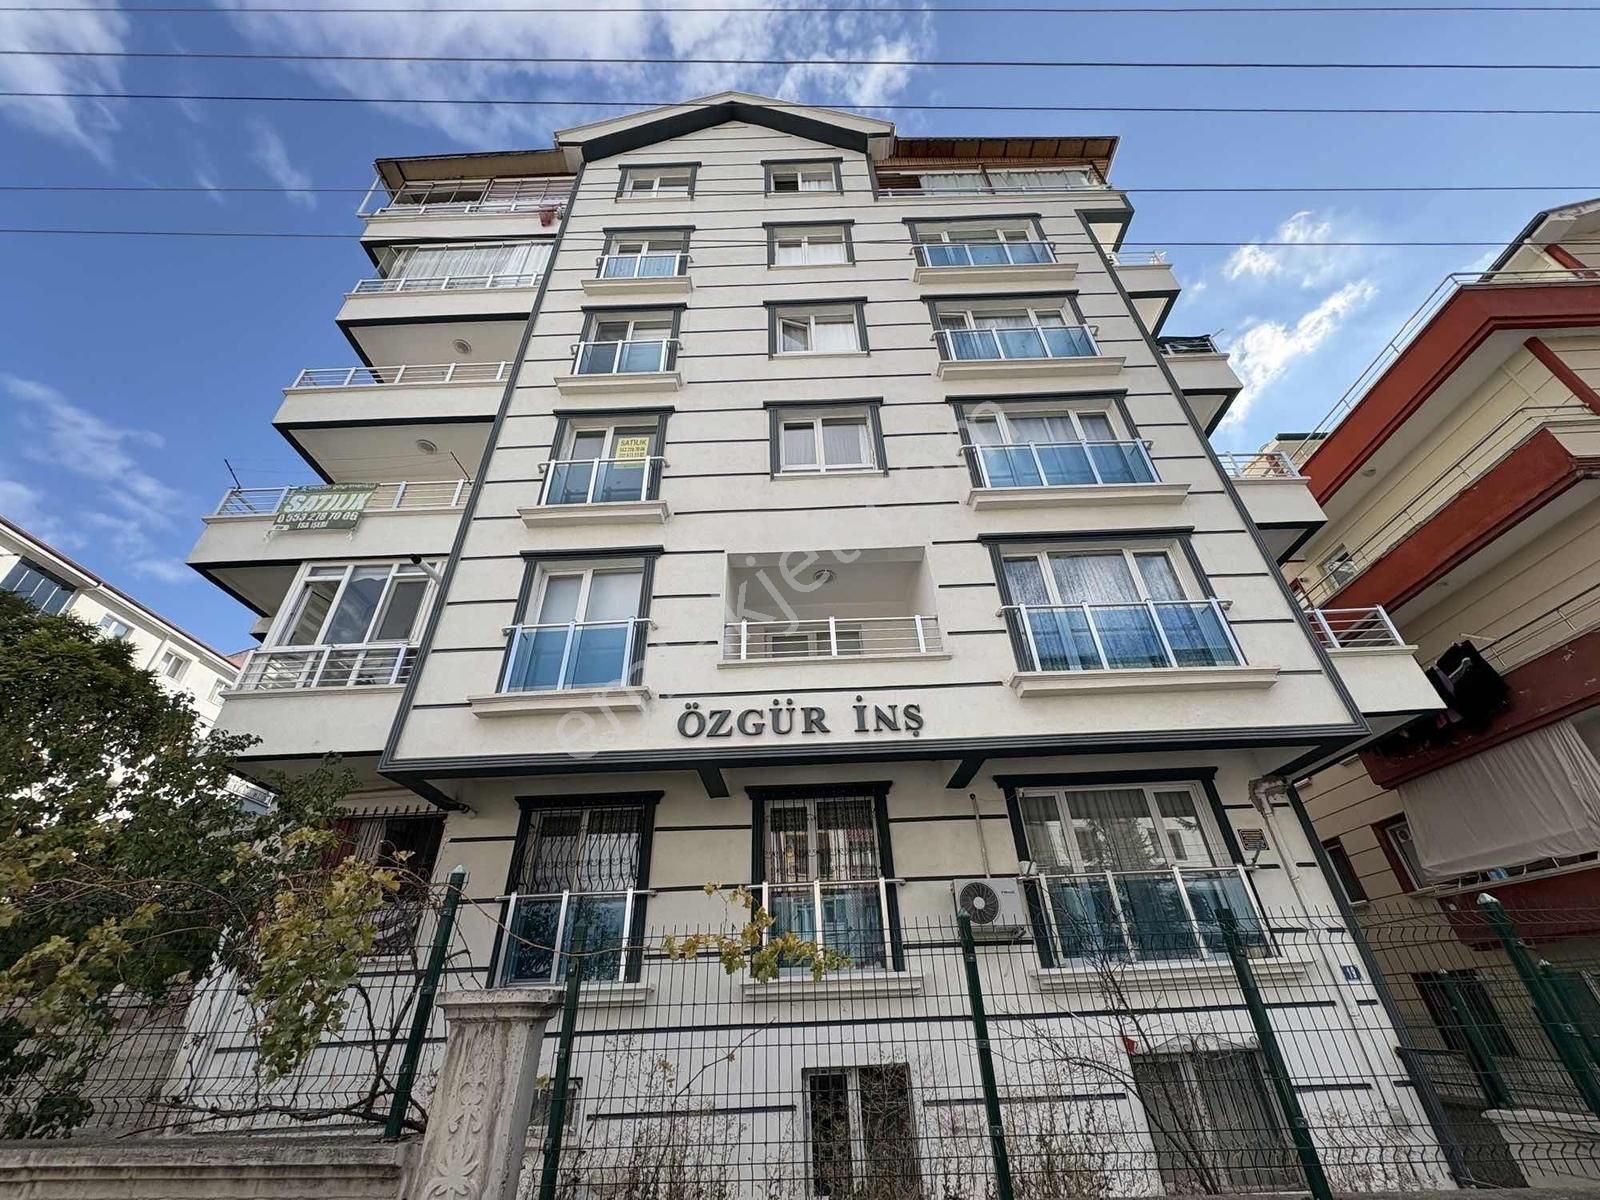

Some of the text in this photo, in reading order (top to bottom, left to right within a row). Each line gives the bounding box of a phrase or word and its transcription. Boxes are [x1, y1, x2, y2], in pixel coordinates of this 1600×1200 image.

[284, 492, 373, 512] SATILIK
[277, 514, 285, 523] 0
[328, 511, 341, 520] 70
[677, 695, 924, 738] ÖZGÜR İNŞ
